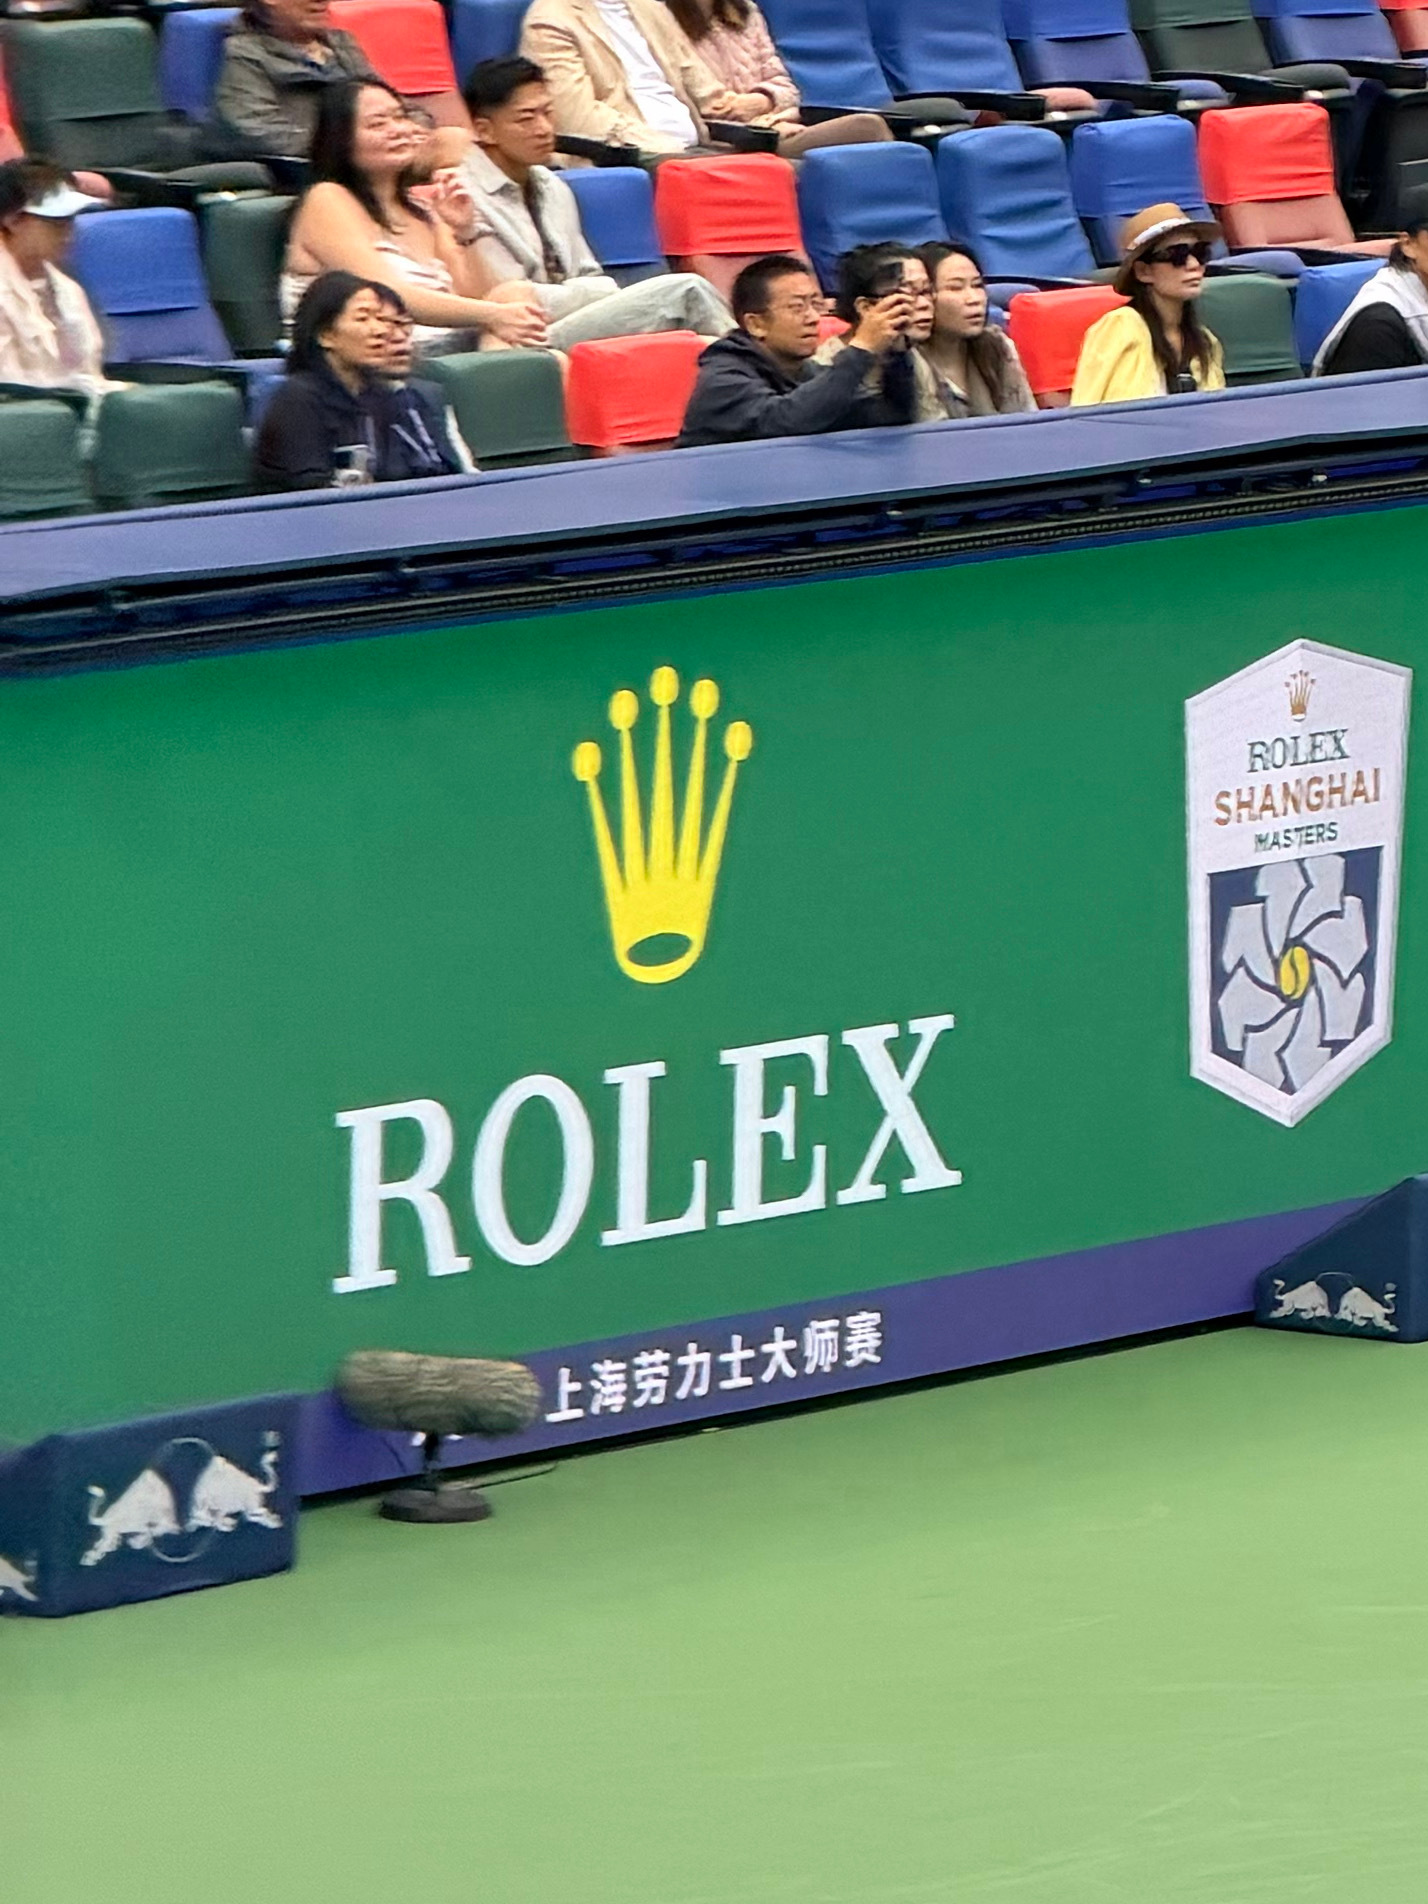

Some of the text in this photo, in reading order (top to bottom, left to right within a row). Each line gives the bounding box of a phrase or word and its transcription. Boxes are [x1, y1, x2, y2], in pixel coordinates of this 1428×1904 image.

[1247, 728, 1350, 774] ROLEX
[1214, 767, 1381, 827] SHANGHAI
[1254, 821, 1339, 854] MASTERS
[333, 1014, 962, 1294] ROLEX
[545, 1310, 882, 1423] 上海劳力士大师赛
